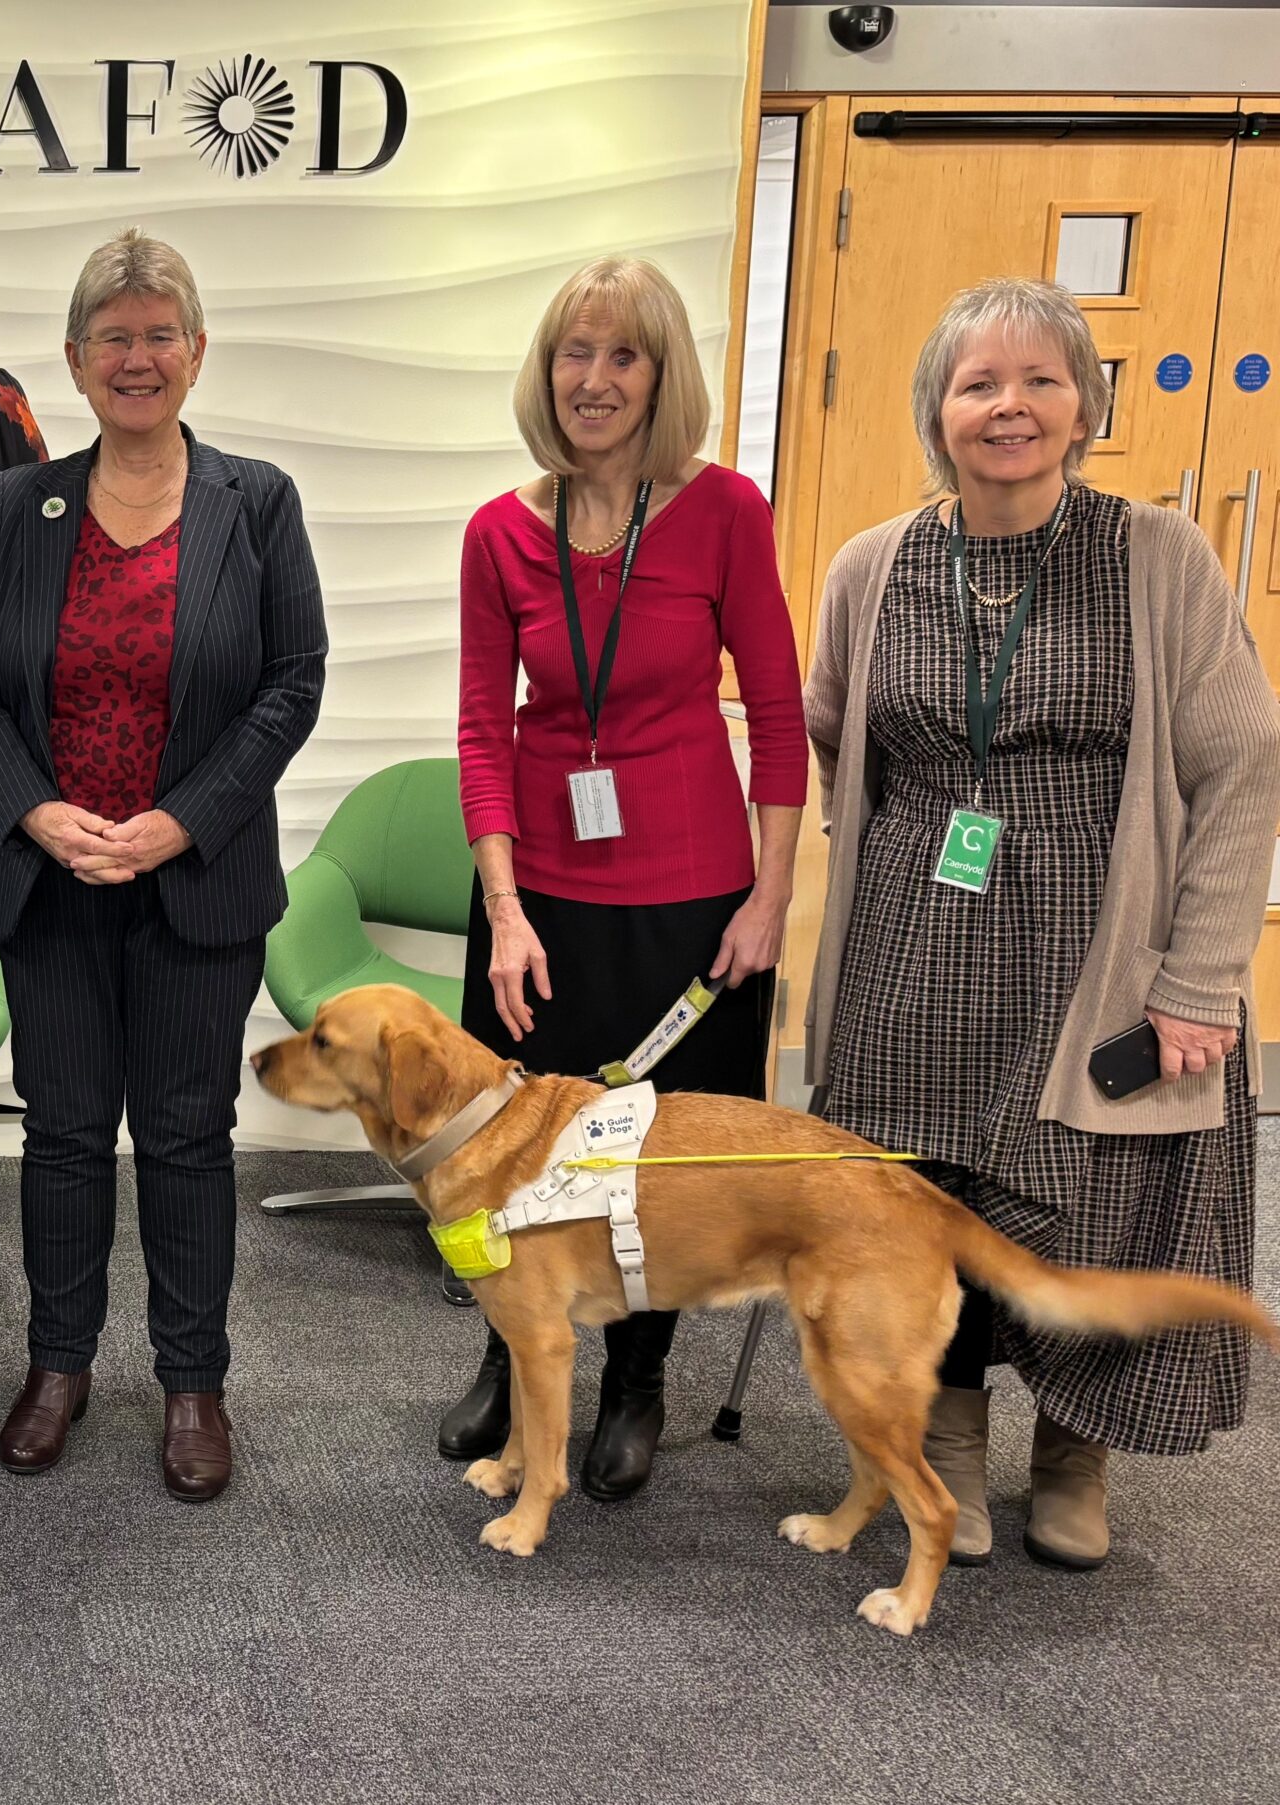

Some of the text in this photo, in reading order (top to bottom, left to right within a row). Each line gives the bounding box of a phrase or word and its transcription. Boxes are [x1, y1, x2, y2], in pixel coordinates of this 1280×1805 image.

[962, 826, 984, 852] C
[944, 858, 984, 875] Caerdydd
[607, 1116, 634, 1126] Guide
[609, 1125, 632, 1134] Dogs
